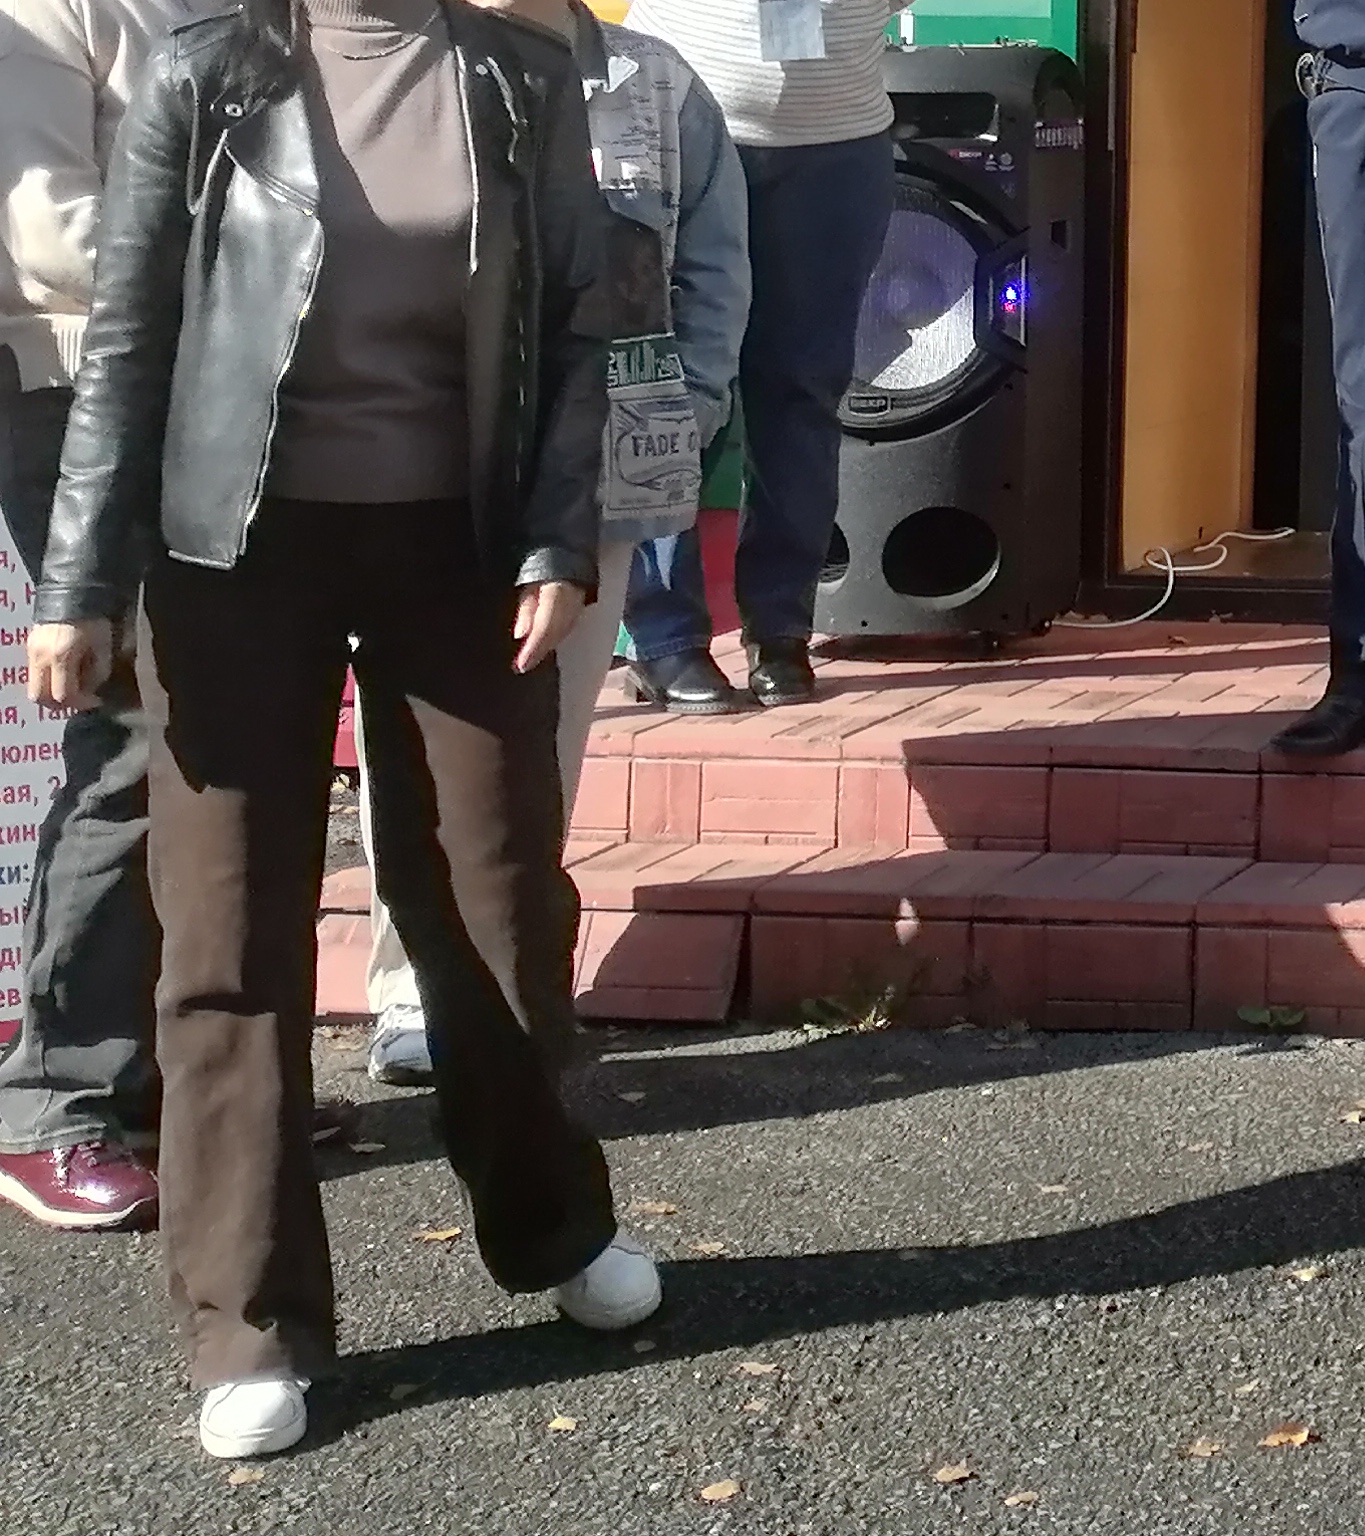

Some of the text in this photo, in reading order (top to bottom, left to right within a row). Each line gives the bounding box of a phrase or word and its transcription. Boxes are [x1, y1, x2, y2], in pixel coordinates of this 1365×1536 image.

[631, 431, 680, 457] FADE
[0, 666, 29, 690] на
[0, 705, 26, 729] я,
[0, 784, 38, 807] ая,
